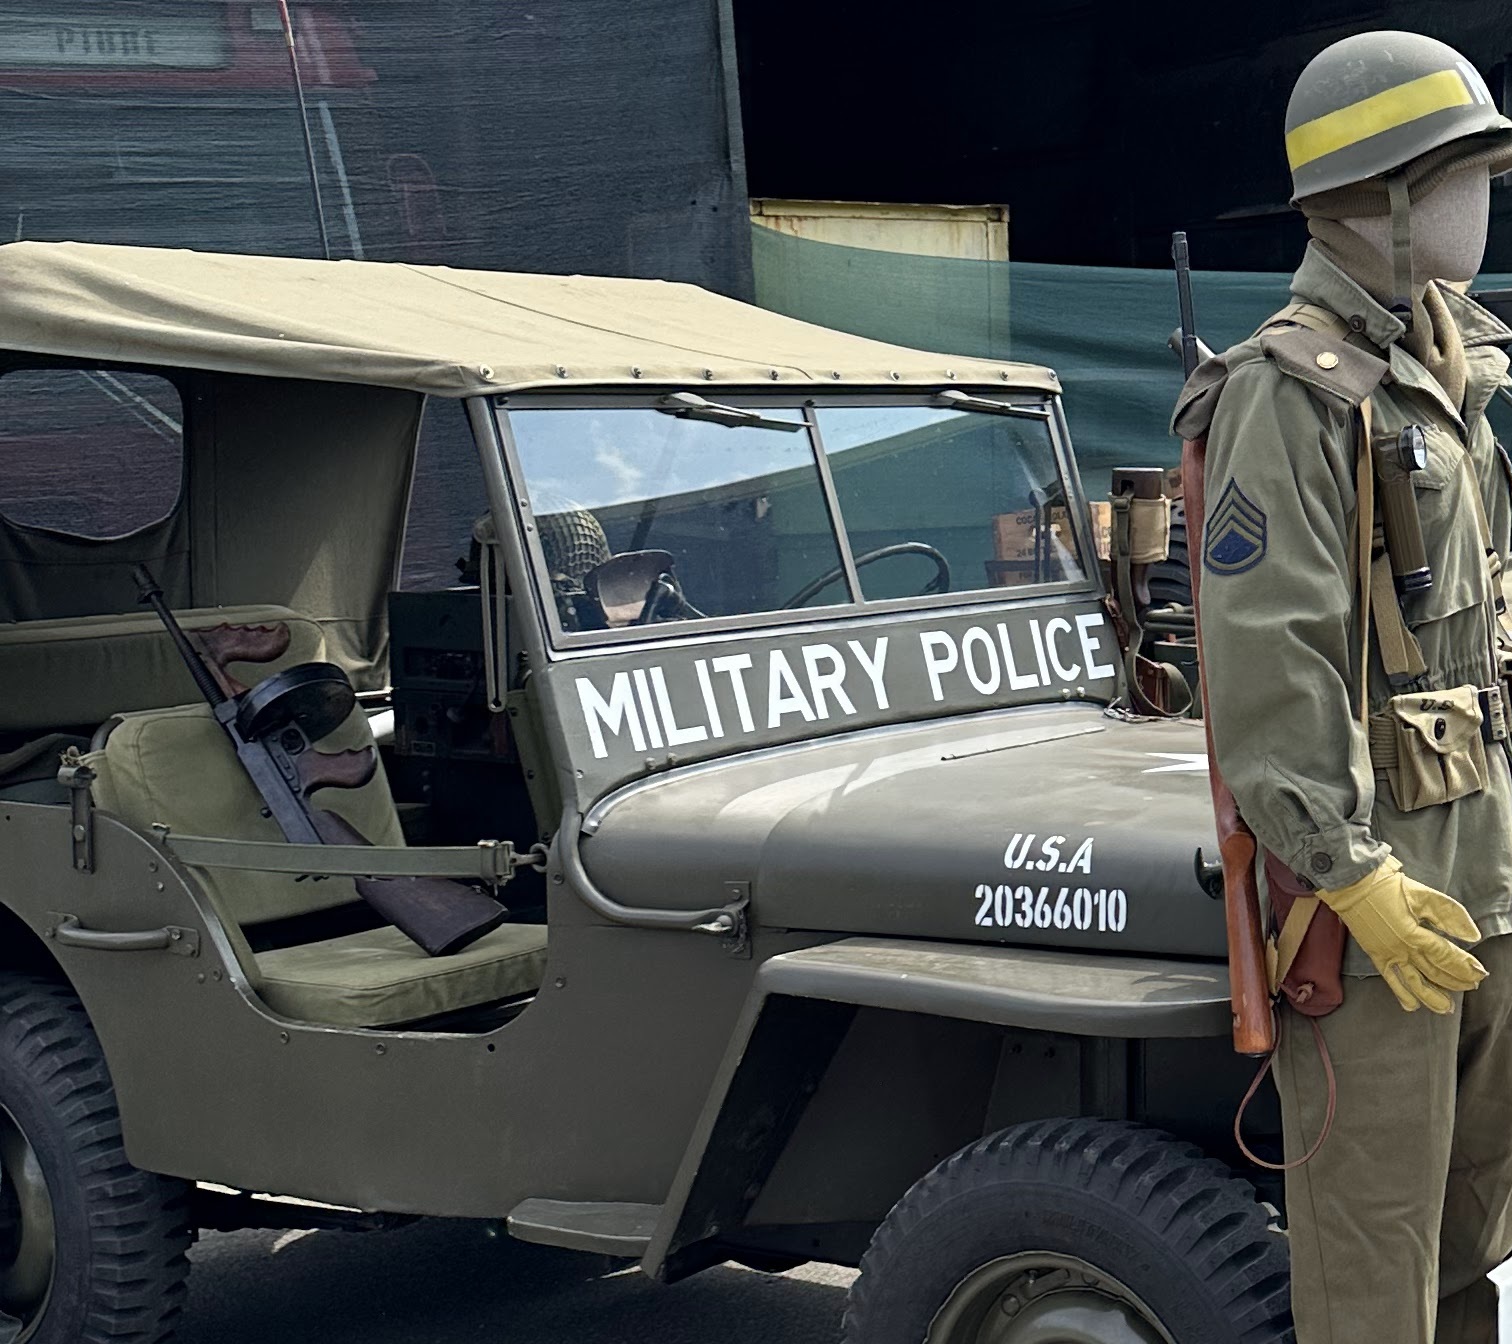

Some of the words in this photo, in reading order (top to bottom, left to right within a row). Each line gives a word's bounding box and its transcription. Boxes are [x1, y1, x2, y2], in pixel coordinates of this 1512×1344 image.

[575, 637, 890, 758] MILITARY
[920, 613, 1115, 702] POLICE
[1004, 833, 1095, 874] U.S.A
[974, 884, 1127, 932] 20366010
